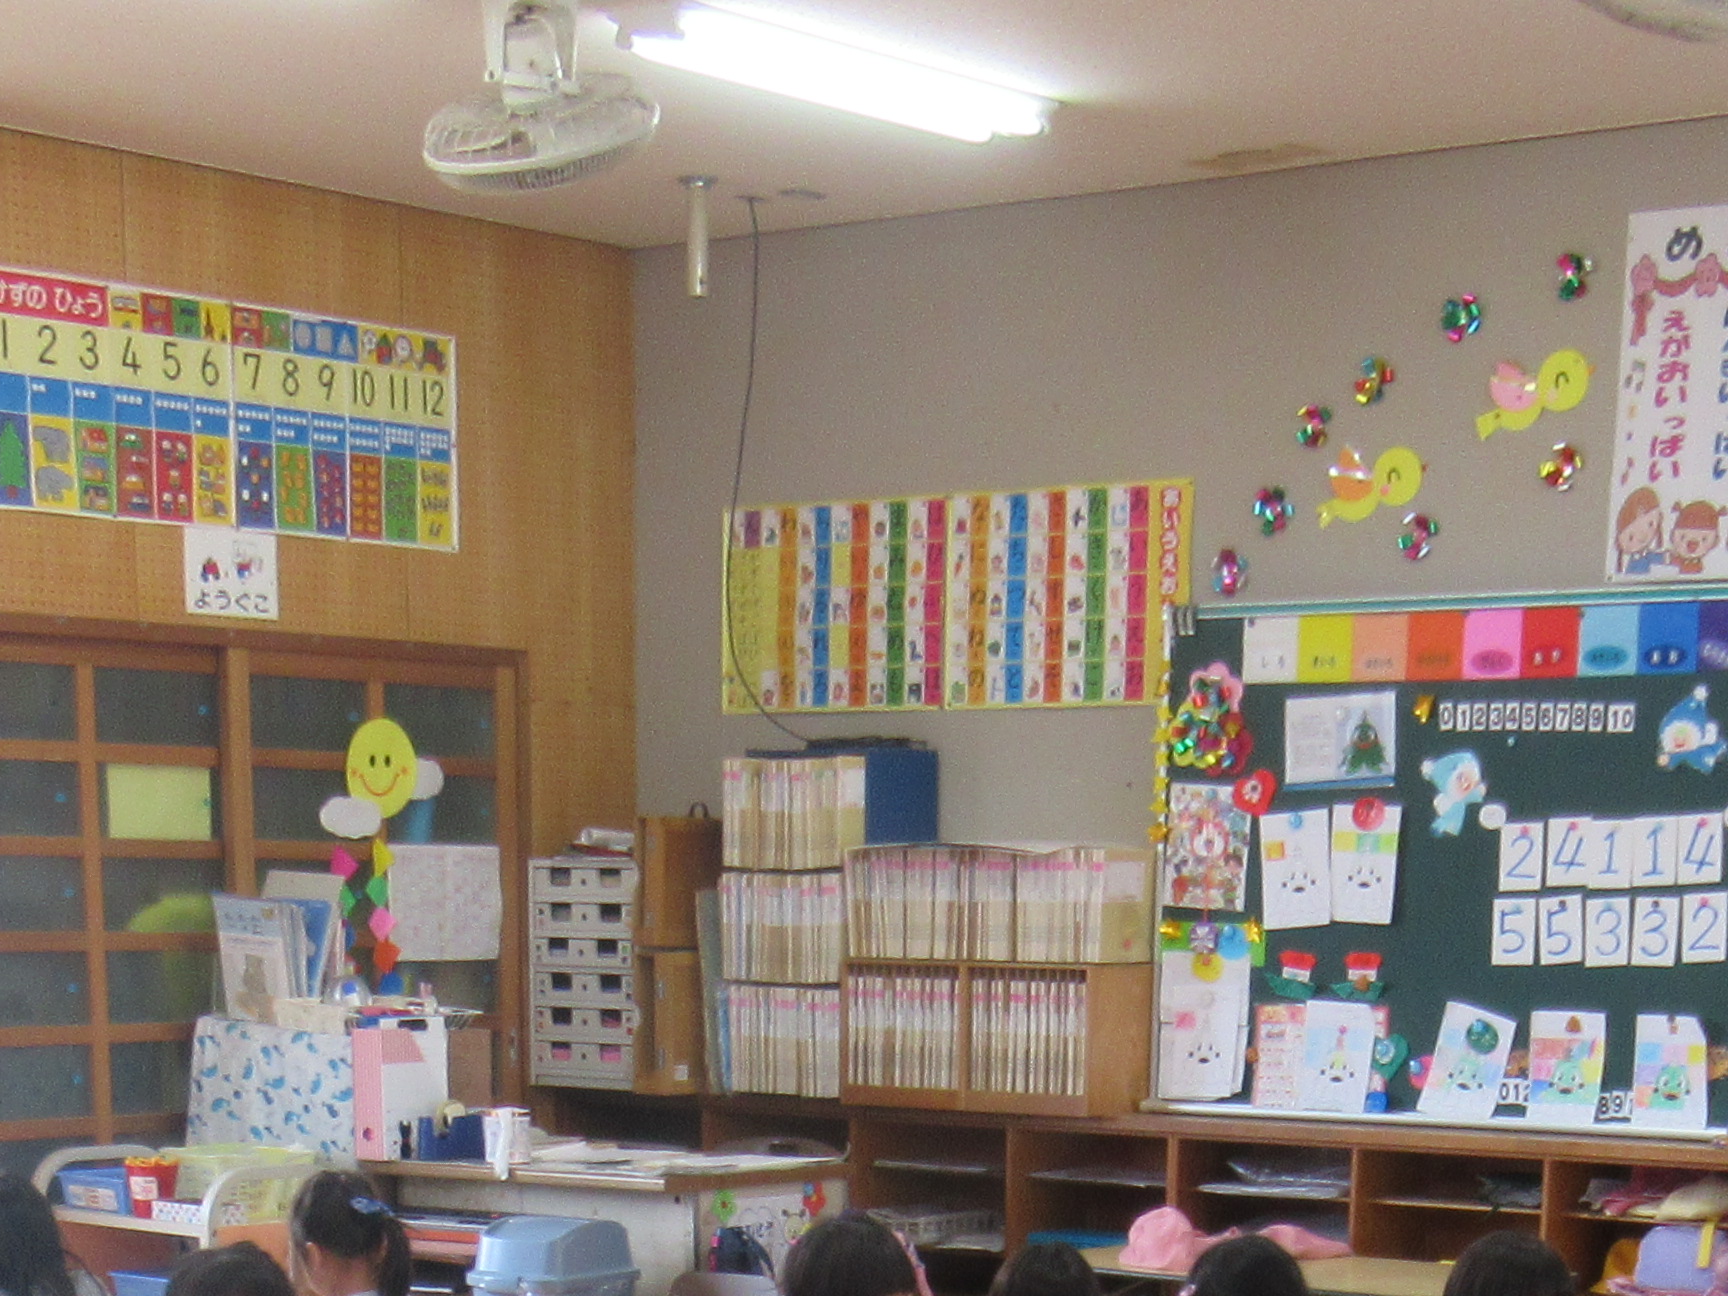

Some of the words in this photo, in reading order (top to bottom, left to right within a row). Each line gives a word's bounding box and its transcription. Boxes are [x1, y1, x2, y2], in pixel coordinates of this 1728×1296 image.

[53, 286, 103, 318] ひょう
[0, 319, 10, 360] 1
[38, 324, 59, 364] 2
[80, 331, 100, 371] 3
[121, 335, 142, 376] 4
[162, 342, 182, 381] 5
[201, 347, 220, 387] 6
[243, 352, 262, 391] 7
[282, 359, 300, 398] 8
[318, 363, 336, 402] 9
[352, 367, 376, 408] 10
[389, 373, 410, 412] 11
[421, 378, 445, 417] 12
[1649, 310, 1692, 482] えがおいっぱい
[1440, 703, 1453, 728] 0
[1460, 704, 1469, 728] 1
[1473, 704, 1486, 728] 2
[1490, 704, 1503, 728] 3
[1505, 704, 1519, 728] 4
[1523, 704, 1536, 728] 5
[1540, 704, 1553, 728] 6
[1556, 703, 1569, 728] 7
[1573, 703, 1585, 728] 8
[1589, 704, 1602, 728] 9
[1610, 704, 1633, 729] 10
[1506, 836, 1535, 878] 2
[1553, 828, 1586, 872] 4
[1598, 832, 1619, 874] 1
[1642, 827, 1663, 877] 1
[1683, 825, 1714, 874] 4
[1500, 910, 1525, 953] 5
[1546, 906, 1571, 957] 5
[1595, 910, 1621, 957] 3
[1640, 911, 1668, 957] 3
[1688, 906, 1719, 950] 2
